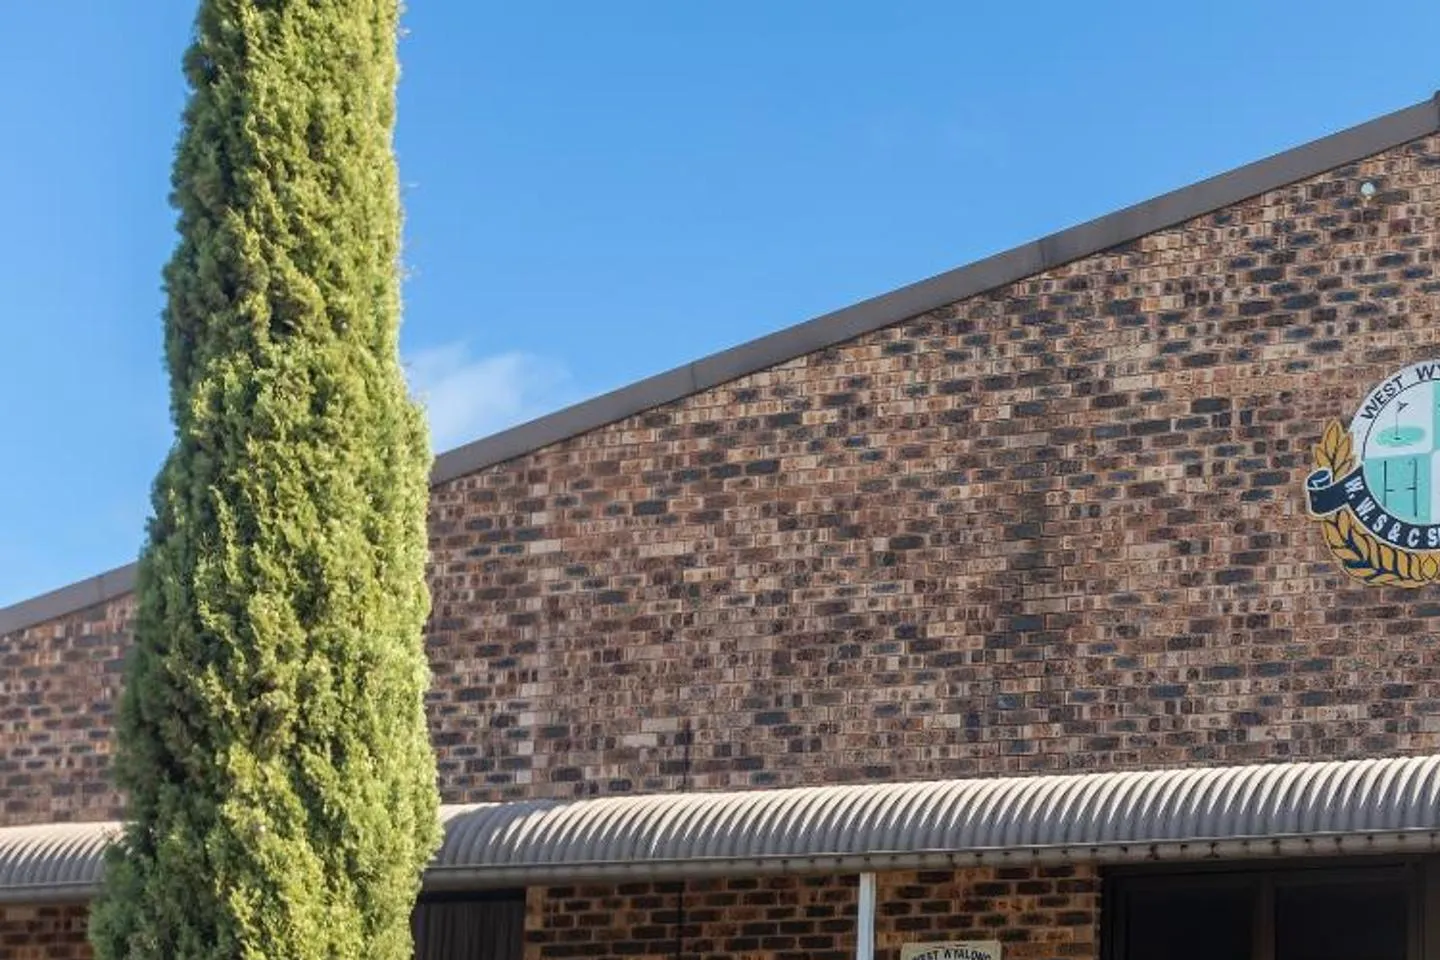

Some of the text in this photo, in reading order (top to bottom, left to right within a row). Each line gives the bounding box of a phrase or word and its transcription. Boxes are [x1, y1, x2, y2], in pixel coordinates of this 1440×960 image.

[1361, 375, 1405, 421] WEST
[1372, 514, 1388, 533] S
[1388, 523, 1402, 542] &
[1407, 528, 1421, 547] C
